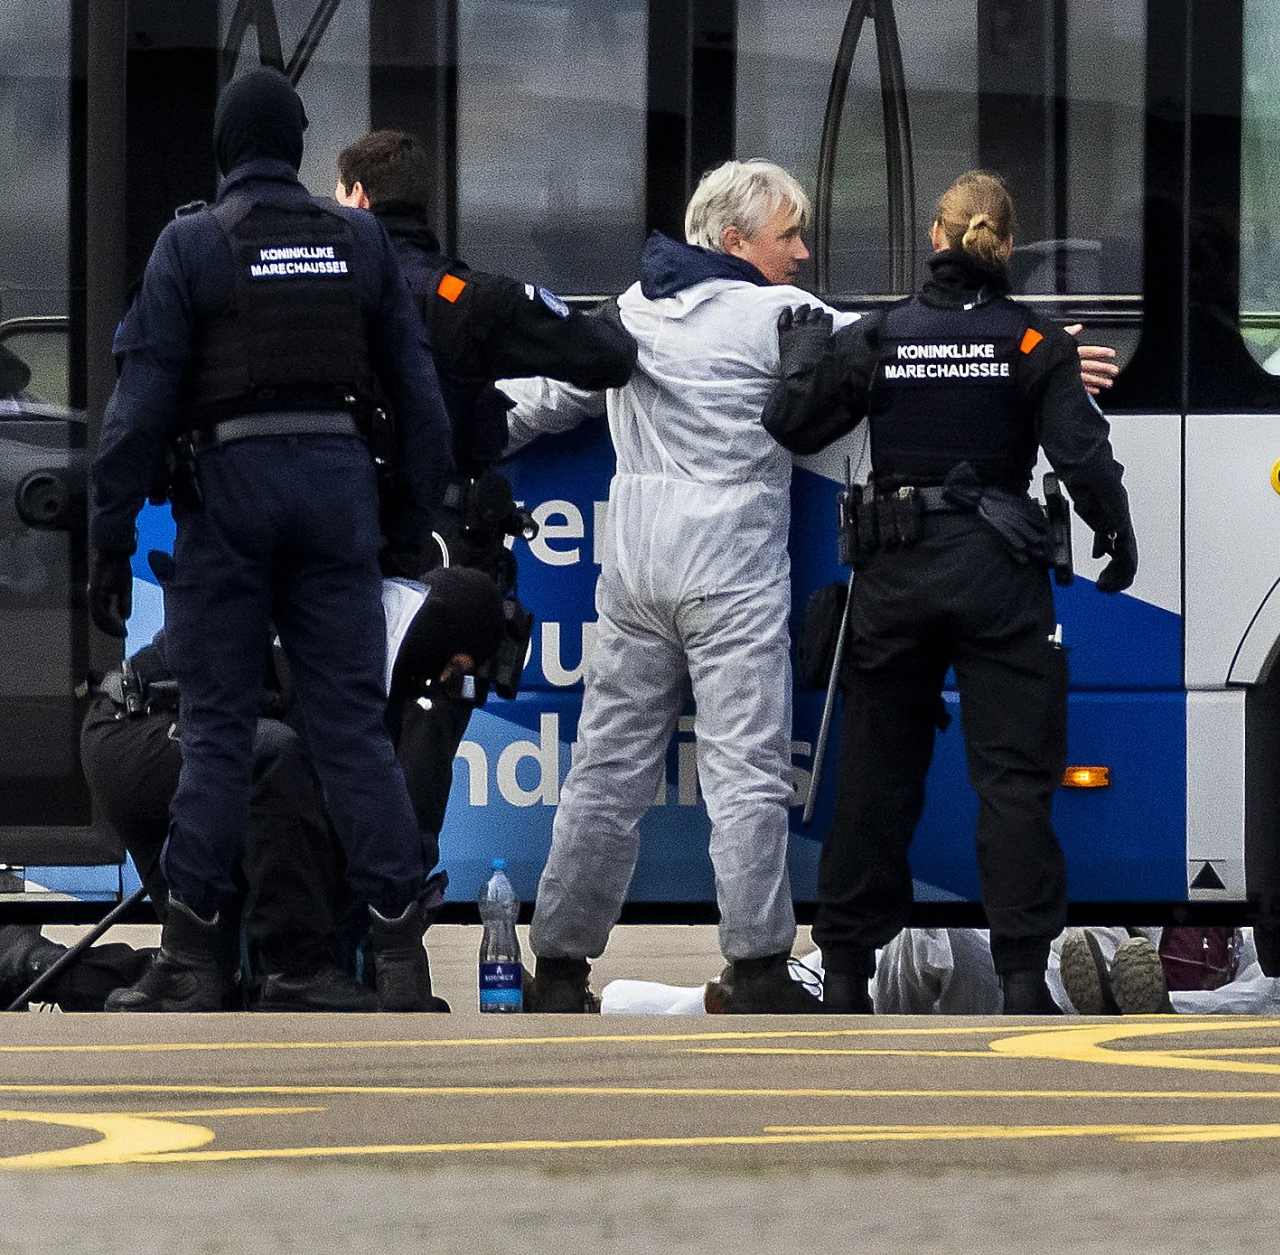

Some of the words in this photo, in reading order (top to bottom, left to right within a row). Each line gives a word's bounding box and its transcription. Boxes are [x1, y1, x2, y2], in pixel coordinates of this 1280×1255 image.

[260, 246, 335, 262] KONINKLIJKE
[250, 261, 349, 278] MARECHAUSSEE
[897, 343, 995, 360] KONINKLIJKE
[884, 362, 1010, 379] MARECHAUSSEE
